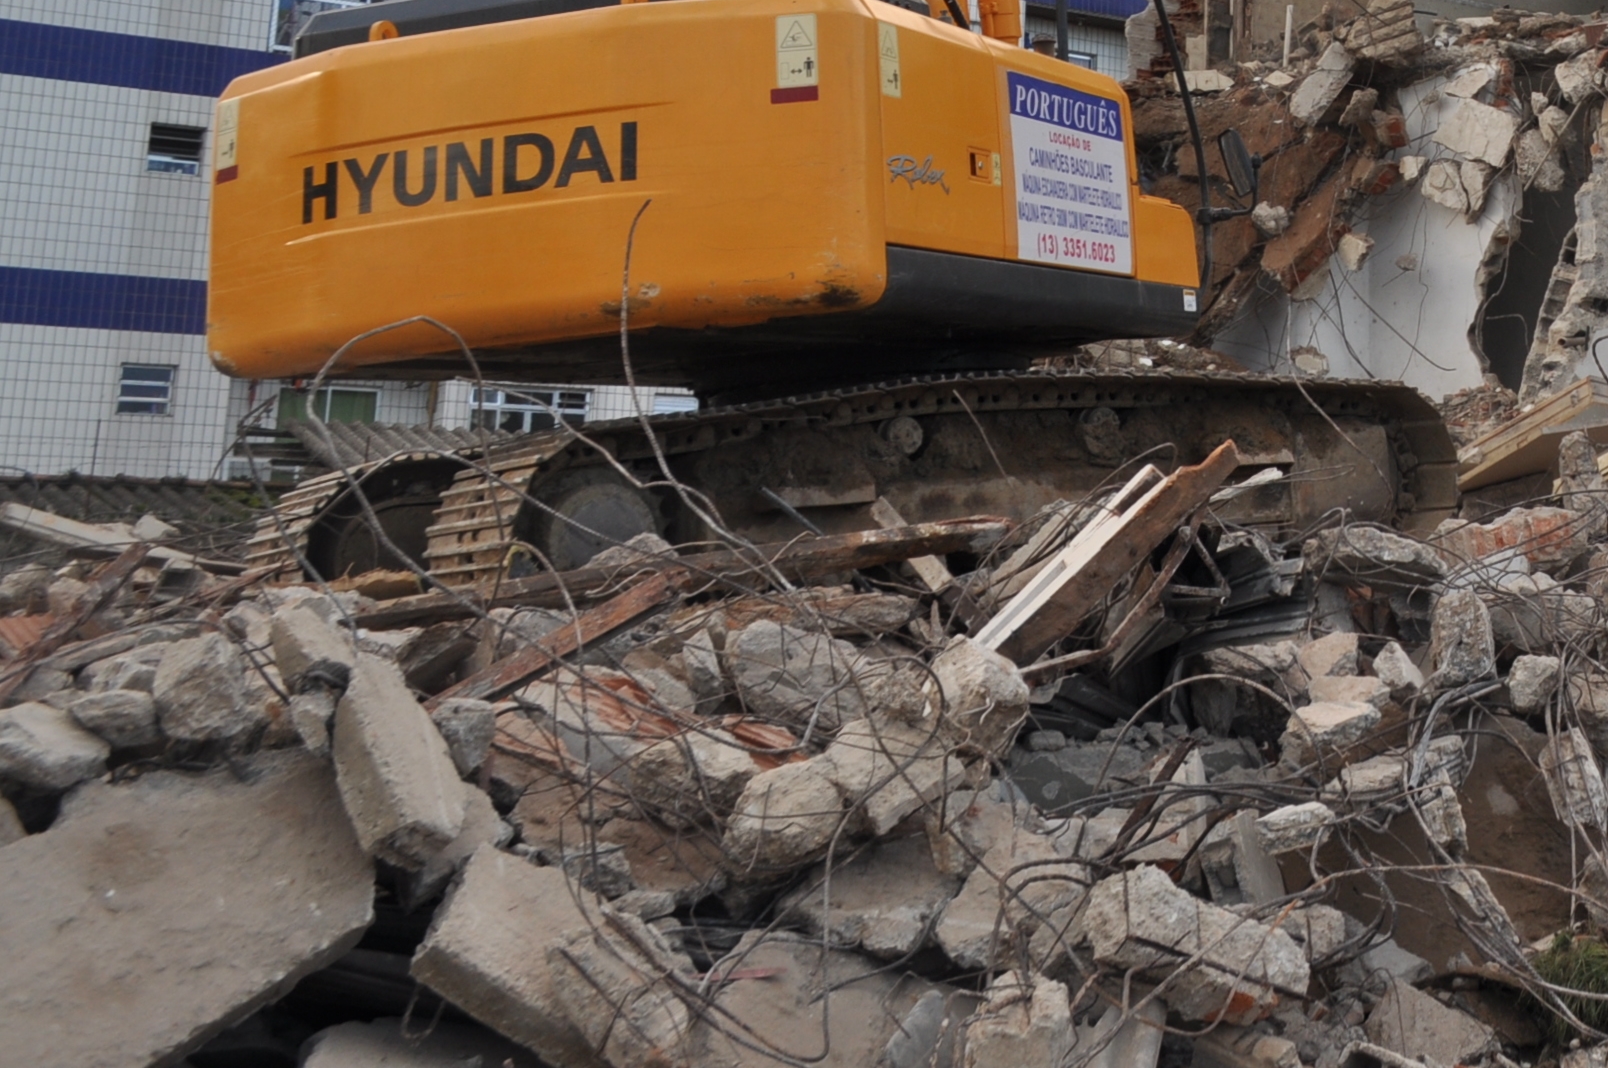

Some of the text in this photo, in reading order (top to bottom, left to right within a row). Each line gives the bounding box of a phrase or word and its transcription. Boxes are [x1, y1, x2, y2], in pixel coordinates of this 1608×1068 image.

[1015, 84, 1117, 137] PORTUGUÊS
[1049, 131, 1092, 152] LOCAÇÃO DE
[302, 121, 638, 225] HYUNDAI
[1029, 147, 1113, 183] CAMINHÕES BASCULANTE
[1037, 233, 1115, 263] (13) 3351.6023
